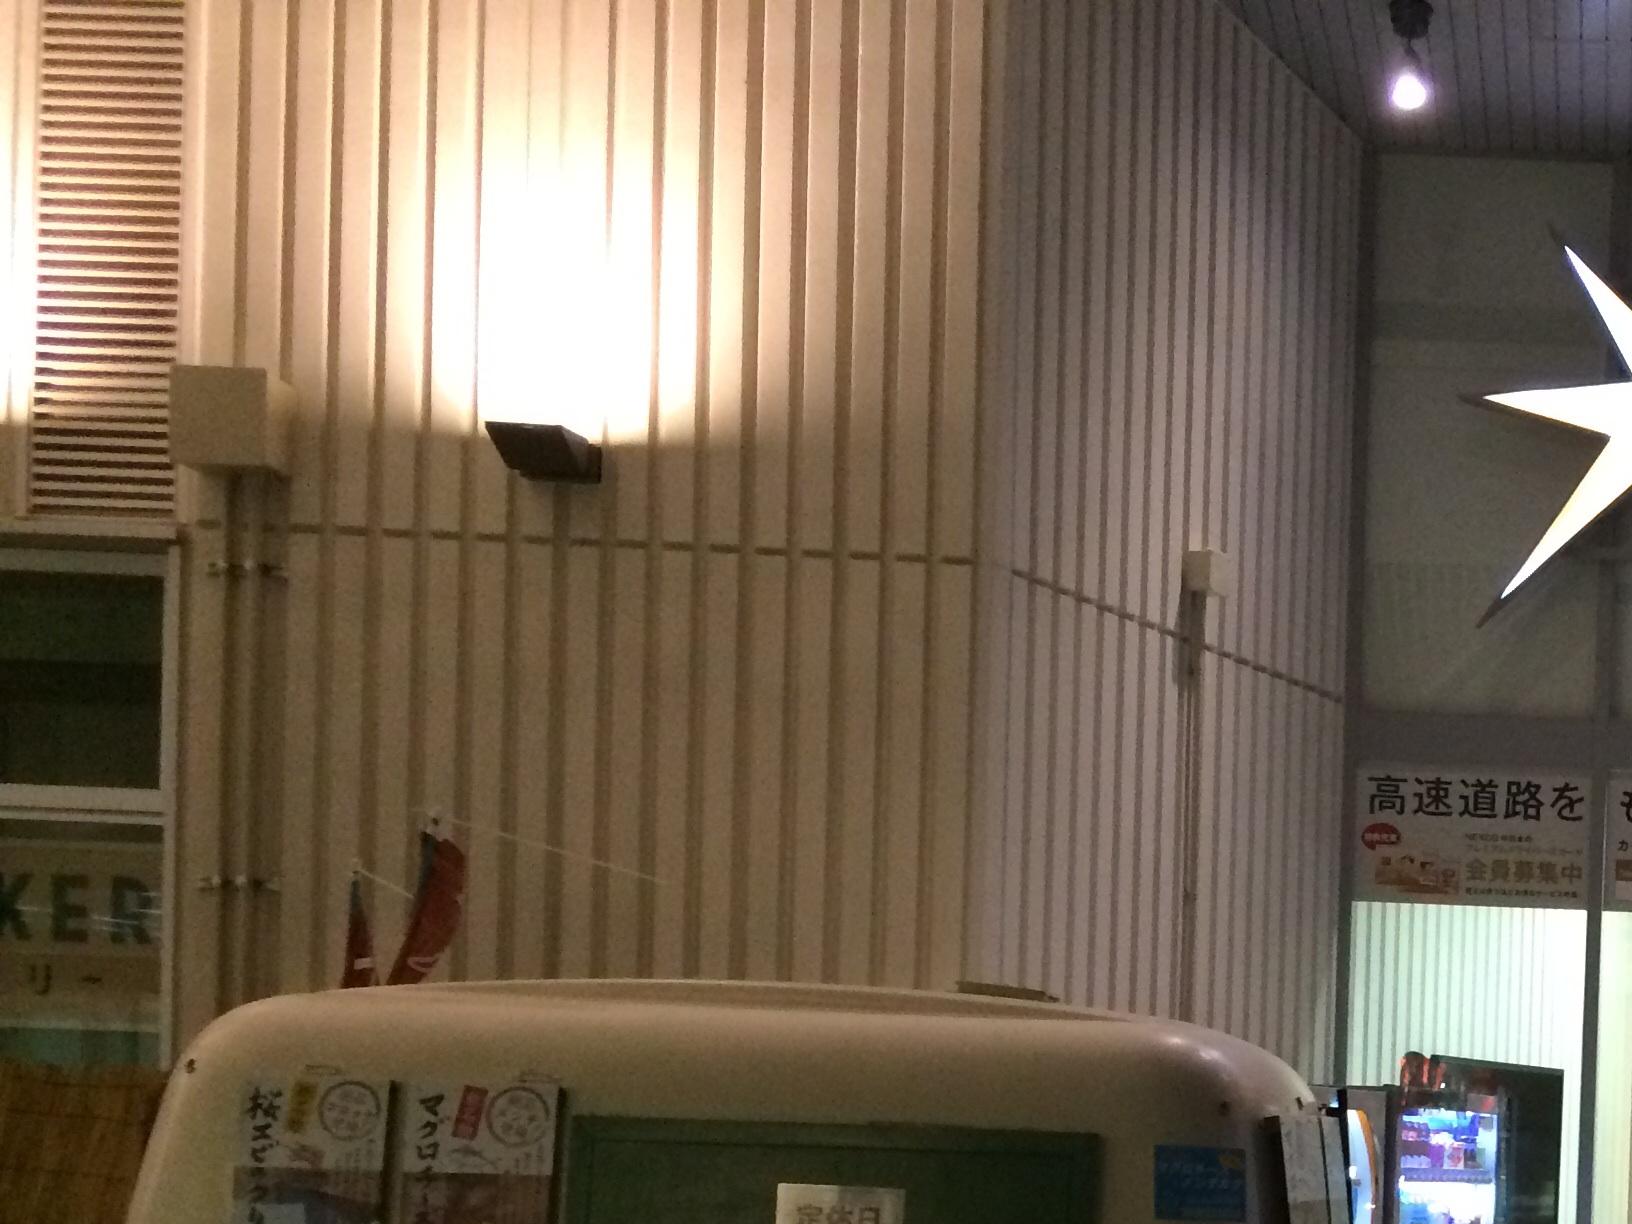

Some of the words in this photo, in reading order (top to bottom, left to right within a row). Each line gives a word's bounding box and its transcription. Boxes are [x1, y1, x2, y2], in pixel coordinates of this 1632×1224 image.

[1366, 773, 1585, 823] 高速道路を
